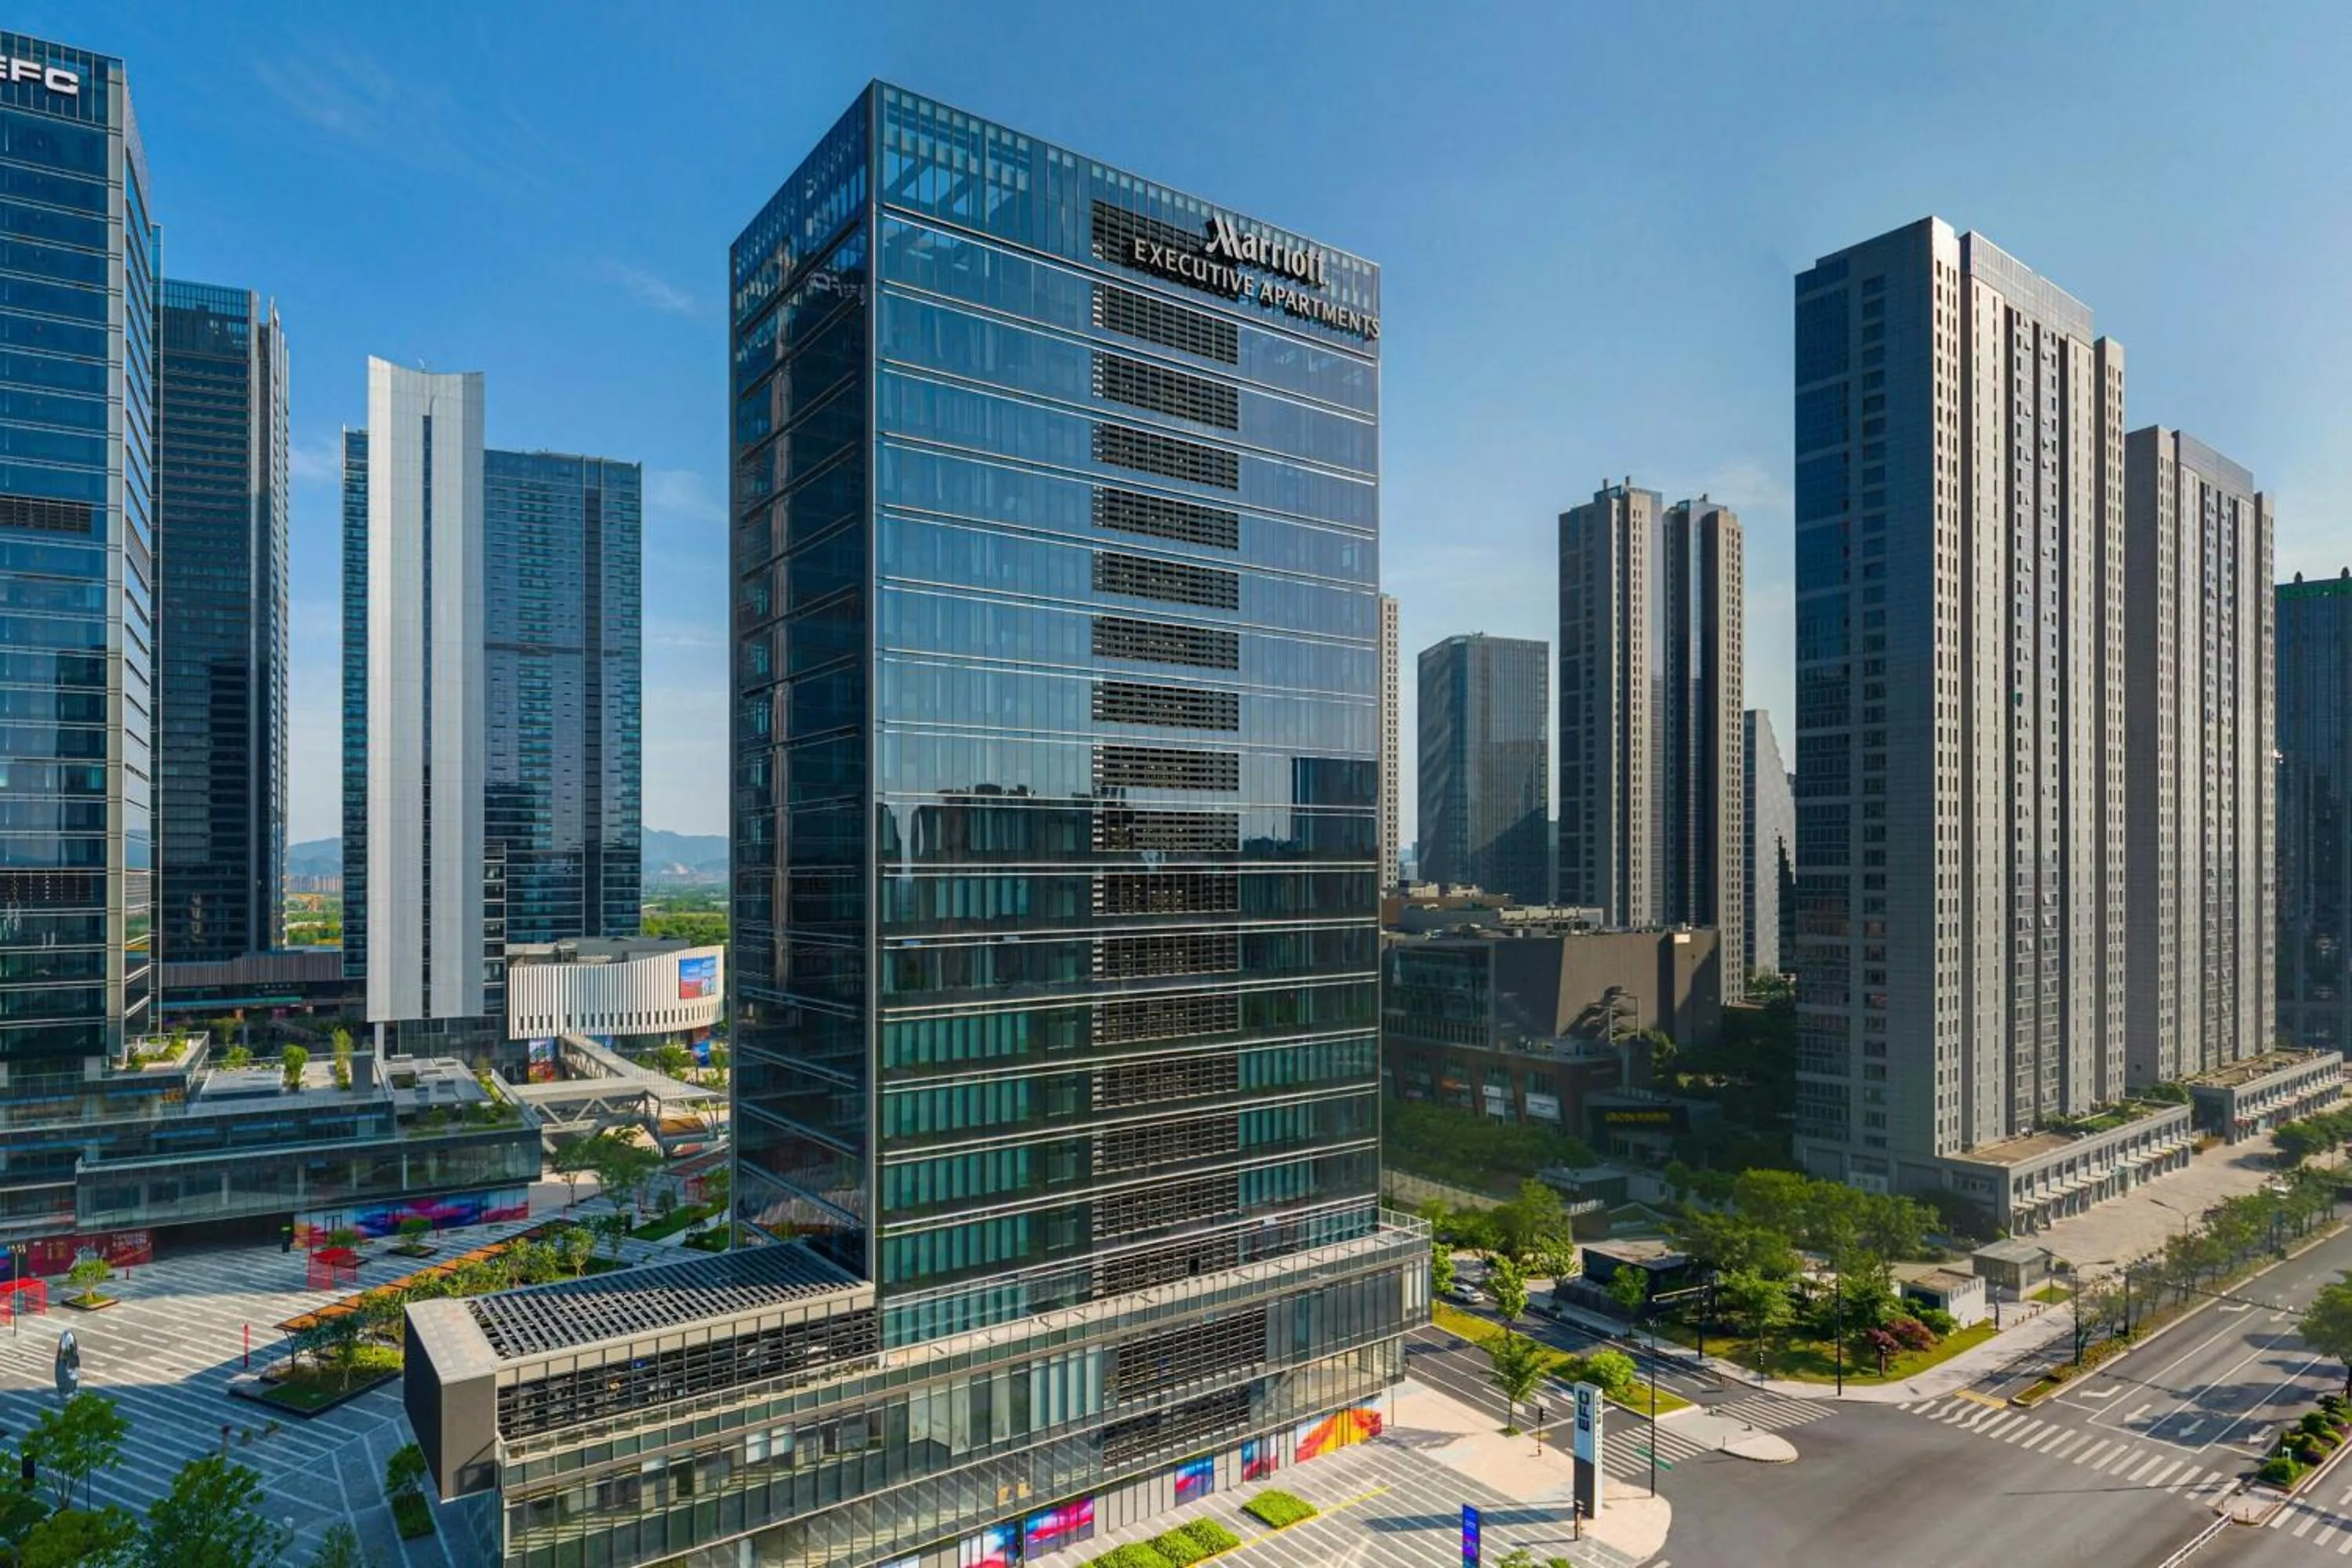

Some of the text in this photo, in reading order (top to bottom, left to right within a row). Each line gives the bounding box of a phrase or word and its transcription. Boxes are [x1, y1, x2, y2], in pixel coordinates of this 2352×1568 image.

[0, 56, 78, 94] FC
[1205, 214, 1328, 285] Marriott
[1134, 238, 1380, 338] EXECUTIVE APARTMENTS
[1578, 1390, 1589, 1432] EFC
